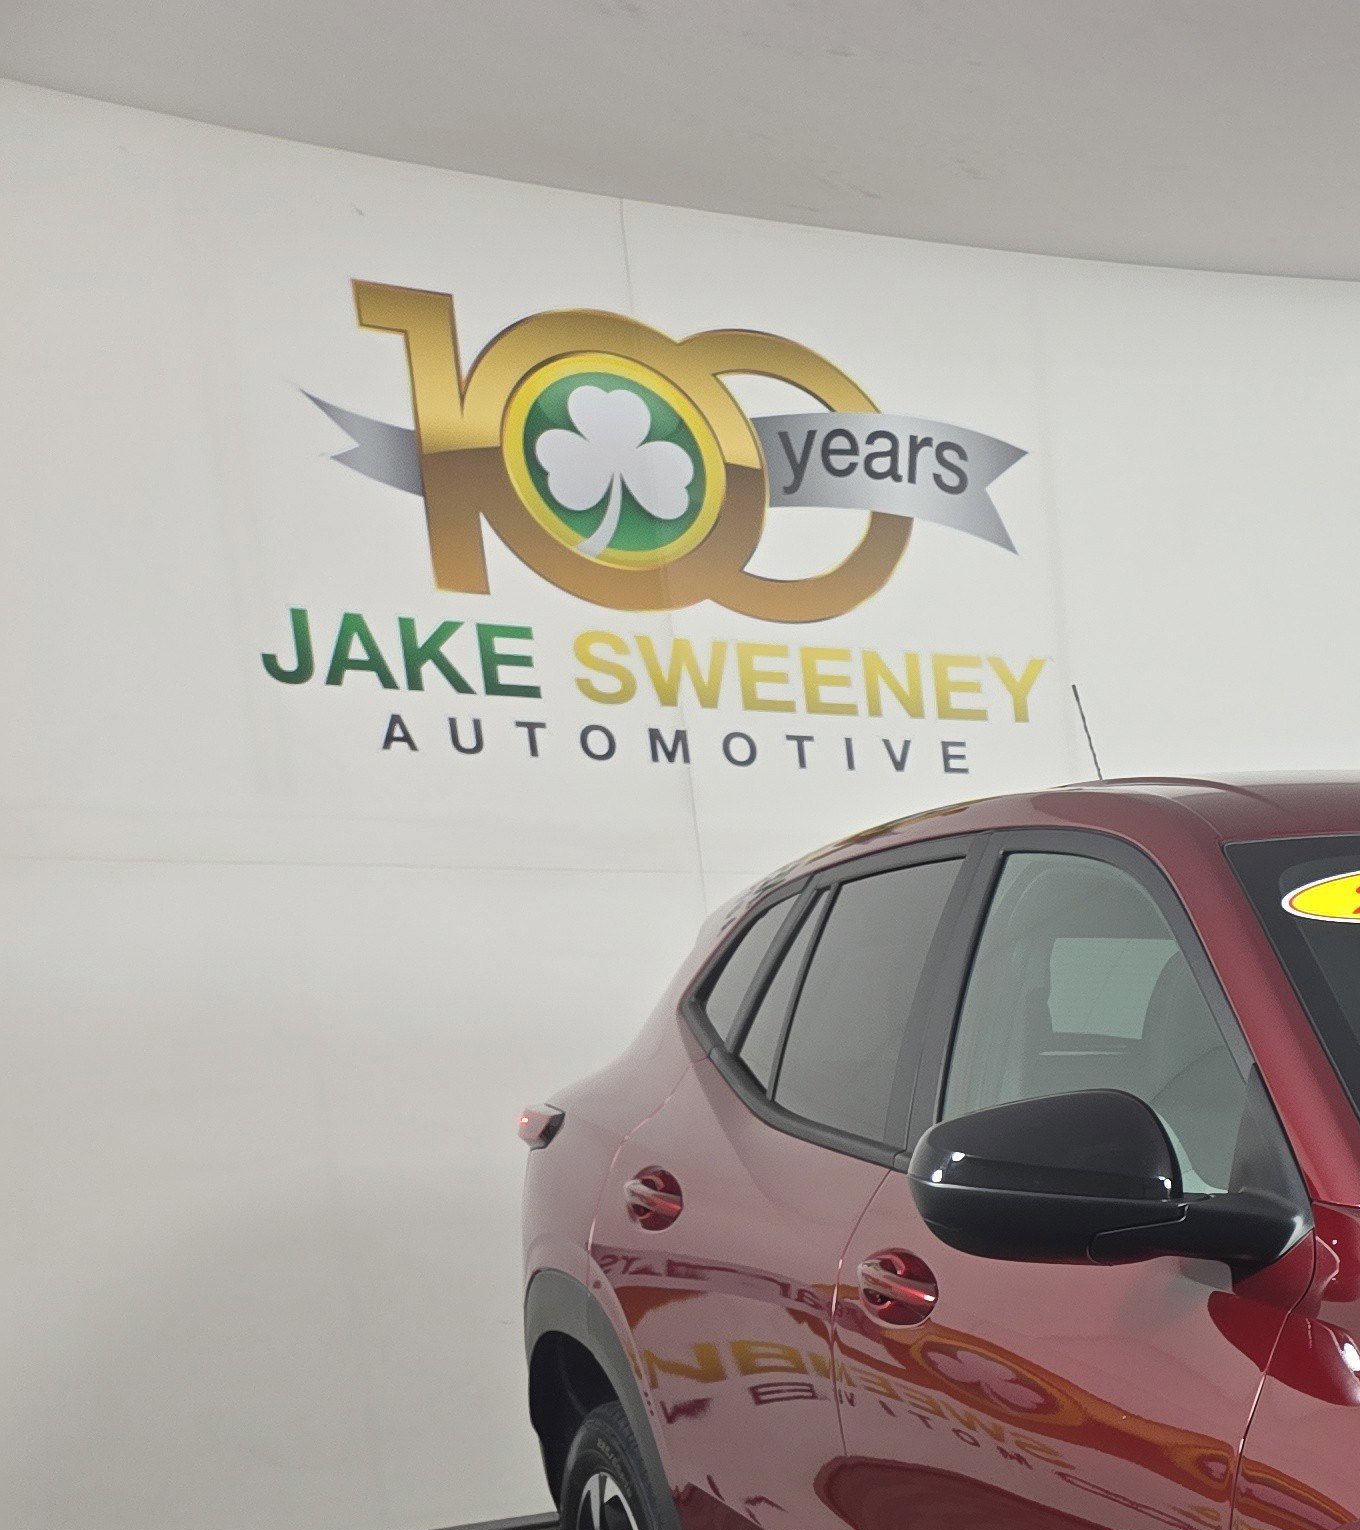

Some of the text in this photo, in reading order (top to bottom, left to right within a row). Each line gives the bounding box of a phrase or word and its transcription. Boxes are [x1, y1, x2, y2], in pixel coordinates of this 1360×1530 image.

[351, 278, 970, 624] 100 years
[261, 607, 1048, 723] JAKE SWEENEY
[381, 713, 970, 775] AUTOMOTIVE
